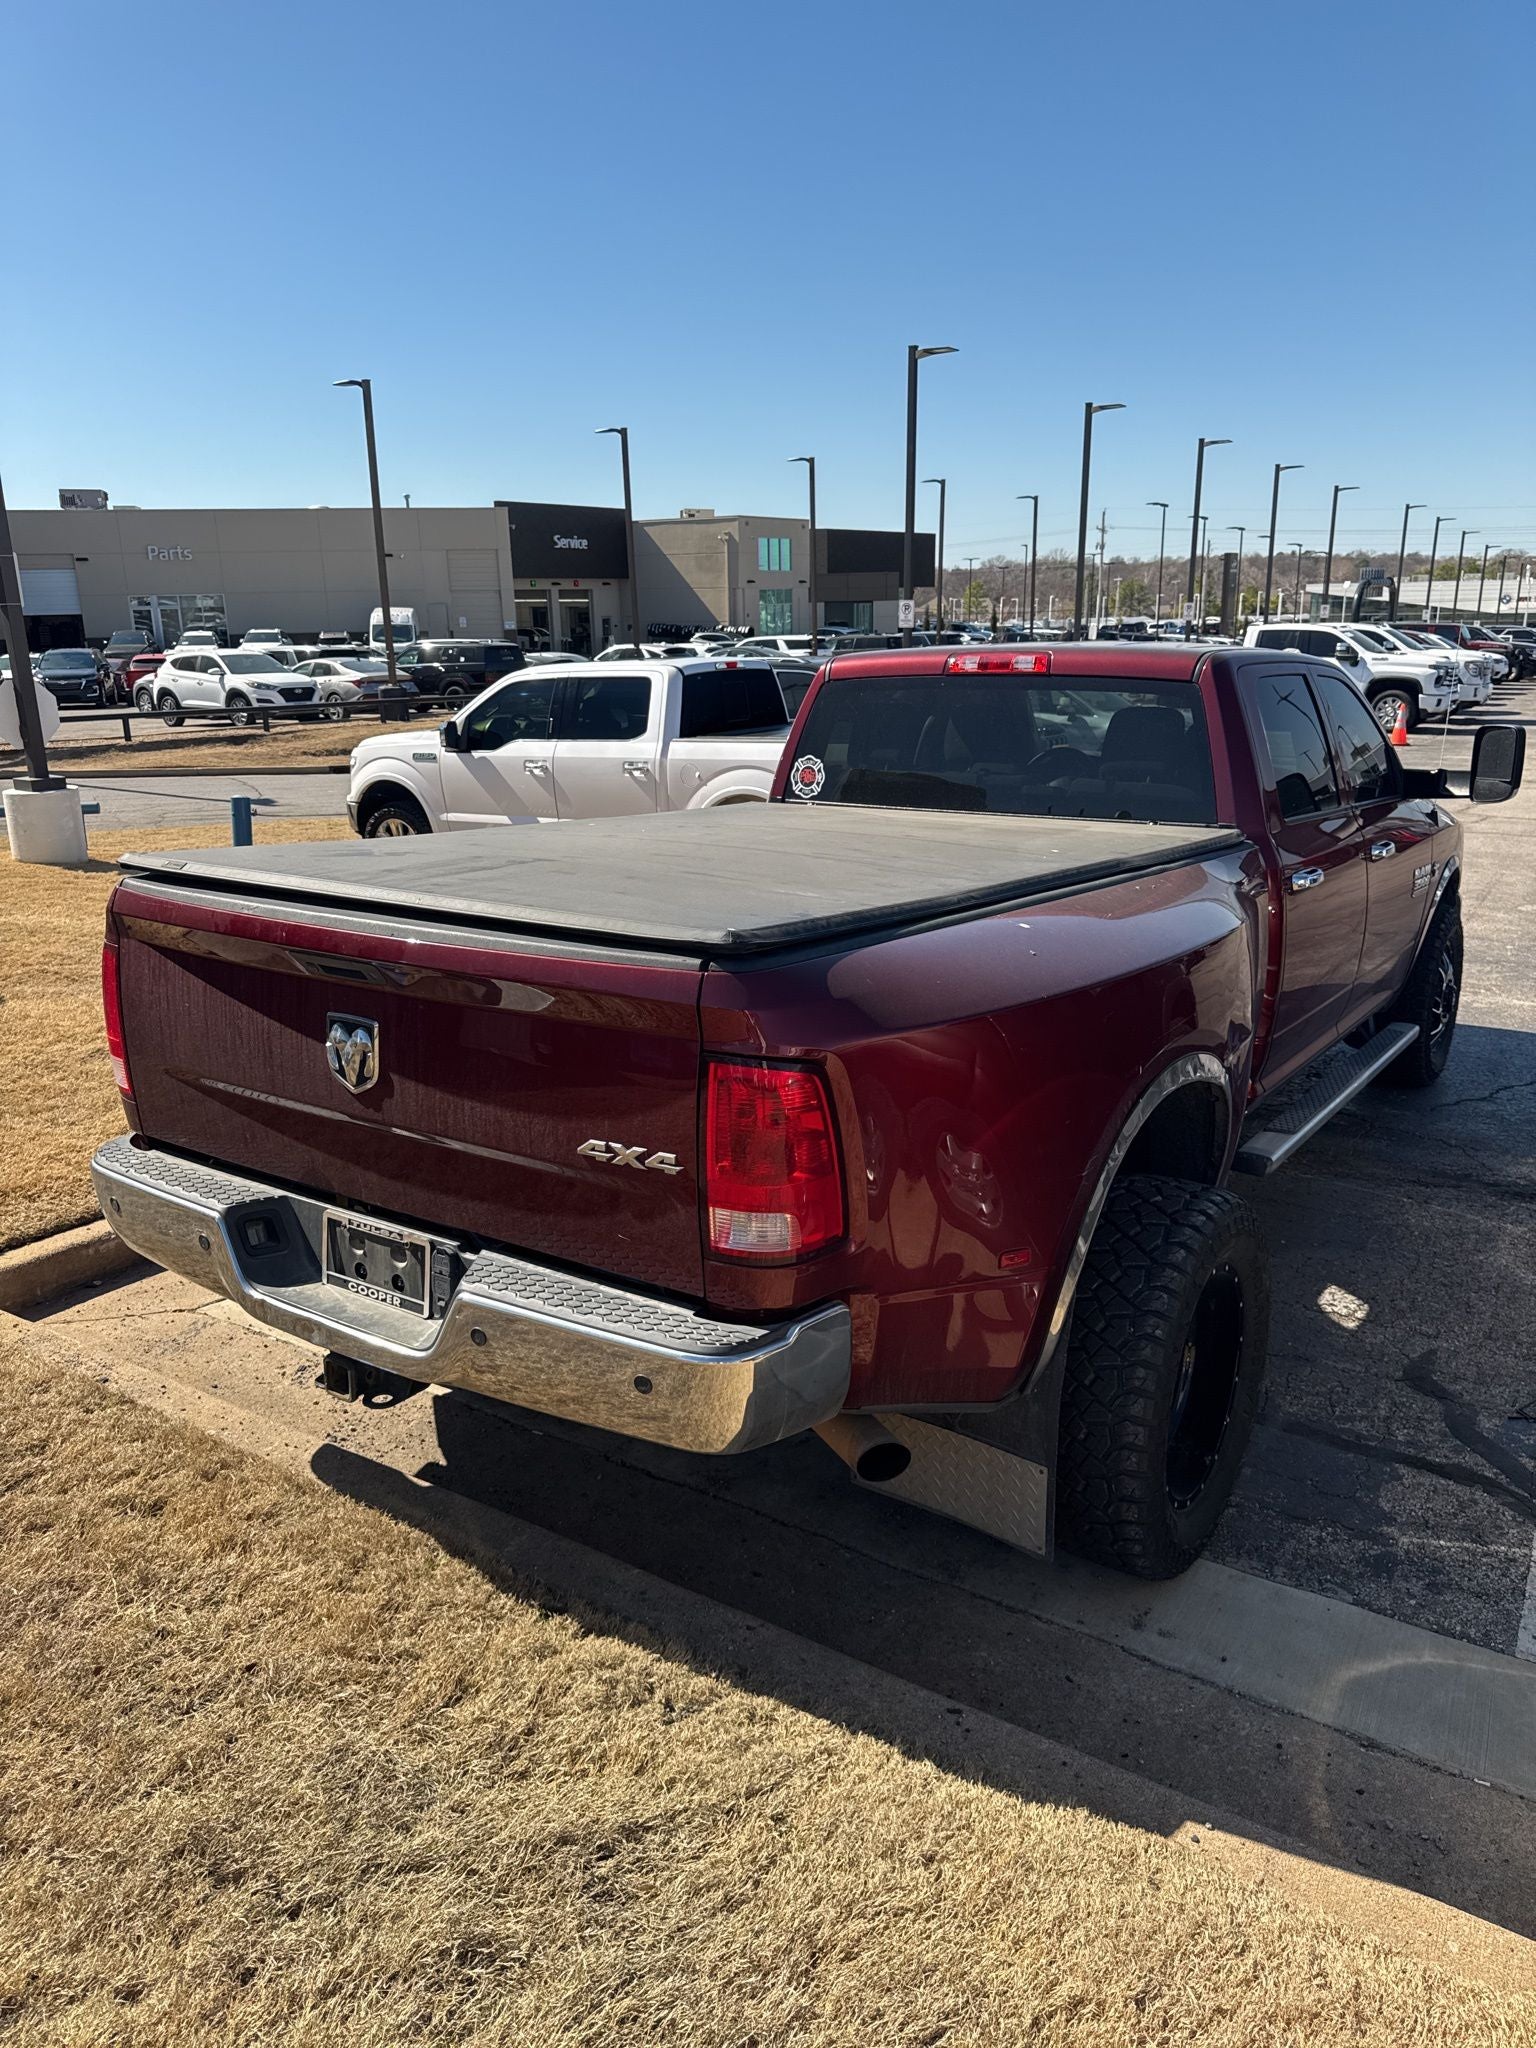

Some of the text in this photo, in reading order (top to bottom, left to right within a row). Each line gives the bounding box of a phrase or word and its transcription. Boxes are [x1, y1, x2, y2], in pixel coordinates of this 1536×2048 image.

[553, 534, 588, 549] Service
[147, 545, 192, 560] Parts
[577, 1139, 685, 1175] 4X4
[350, 1219, 401, 1240] TULSA
[347, 1281, 401, 1308] COOPER
